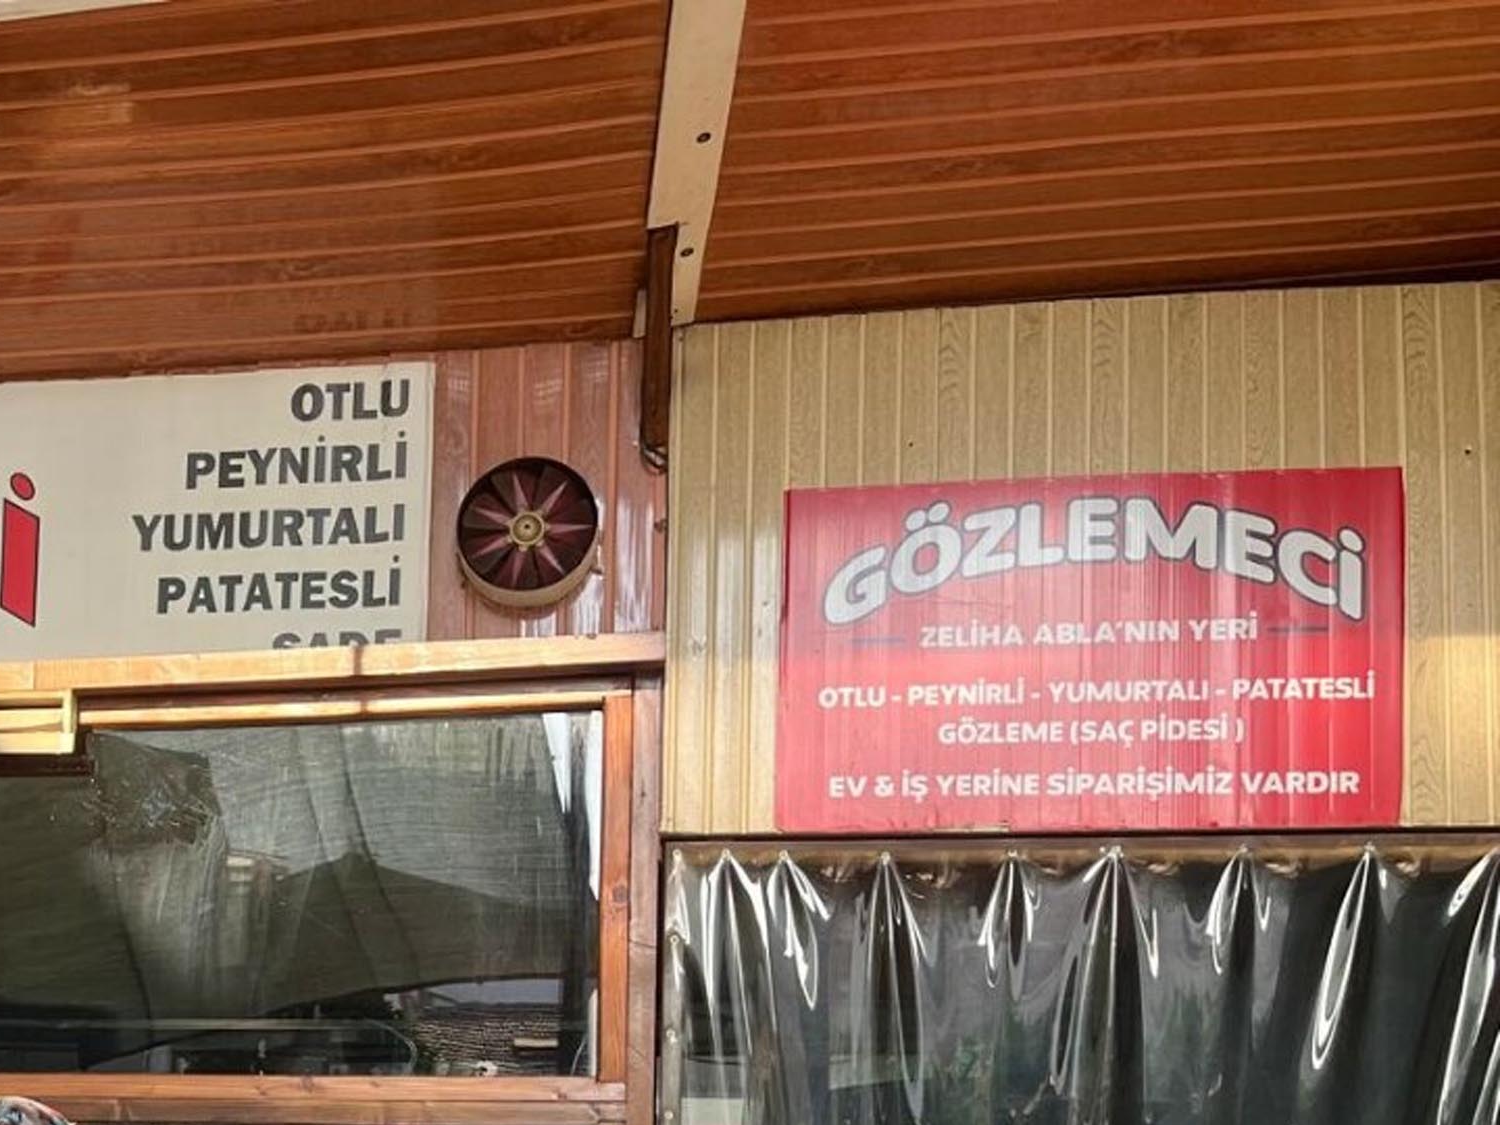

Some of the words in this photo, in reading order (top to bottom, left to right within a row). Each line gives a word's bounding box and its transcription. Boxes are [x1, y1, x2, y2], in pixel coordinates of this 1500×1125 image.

[290, 379, 410, 422] OTLU
[185, 430, 408, 490] PEYNİRLİ
[132, 502, 406, 552] YUMURTALI
[822, 496, 1366, 628] GÖZLEMECİ
[155, 555, 402, 615] PATATESLİ
[920, 619, 1023, 649] ZELİHA
[1189, 611, 1258, 640] YERİ
[818, 686, 886, 709] OTLU
[906, 677, 1025, 706] PEYNİRLİ
[1048, 680, 1208, 703] YUMURTALI
[1232, 669, 1376, 701] PATATESLİ
[938, 717, 1063, 745] GÖZLEME
[1070, 719, 1135, 748] (SAÇ
[1140, 713, 1229, 742] PİDESİ
[828, 775, 868, 799] EV
[874, 775, 896, 797] &
[901, 768, 930, 803] İŞ
[936, 768, 1041, 797] YERİNE
[1046, 766, 1233, 800] SİPARİŞİMİZ
[1241, 770, 1360, 795] VARDIR
